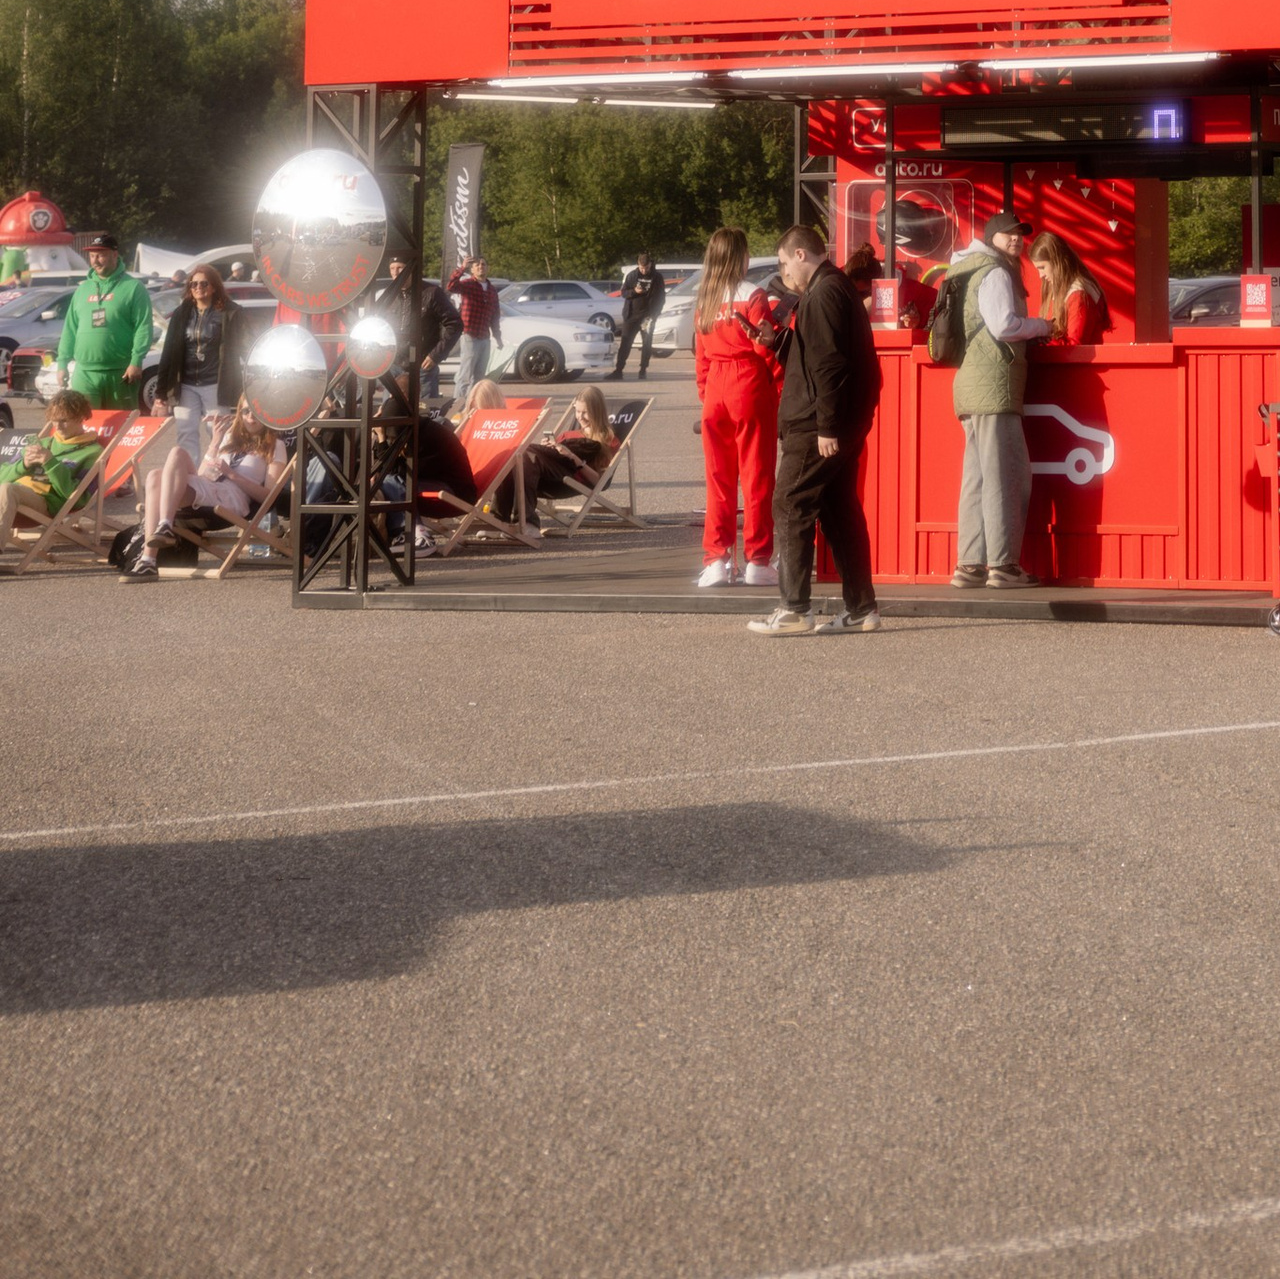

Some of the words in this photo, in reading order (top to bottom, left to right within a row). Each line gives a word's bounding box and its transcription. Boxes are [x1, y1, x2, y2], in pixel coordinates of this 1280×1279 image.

[262, 255, 274, 275] IN
[271, 274, 305, 306] CARS
[306, 292, 331, 310] WE
[332, 253, 370, 301] TRUST
[608, 412, 634, 425] o.ru
[125, 425, 146, 436] ARS
[482, 420, 494, 430] IN
[493, 420, 520, 430] CARS
[472, 430, 489, 440] WE
[489, 429, 520, 440] TRUST
[9, 435, 21, 446] IN
[0, 446, 16, 456] WE
